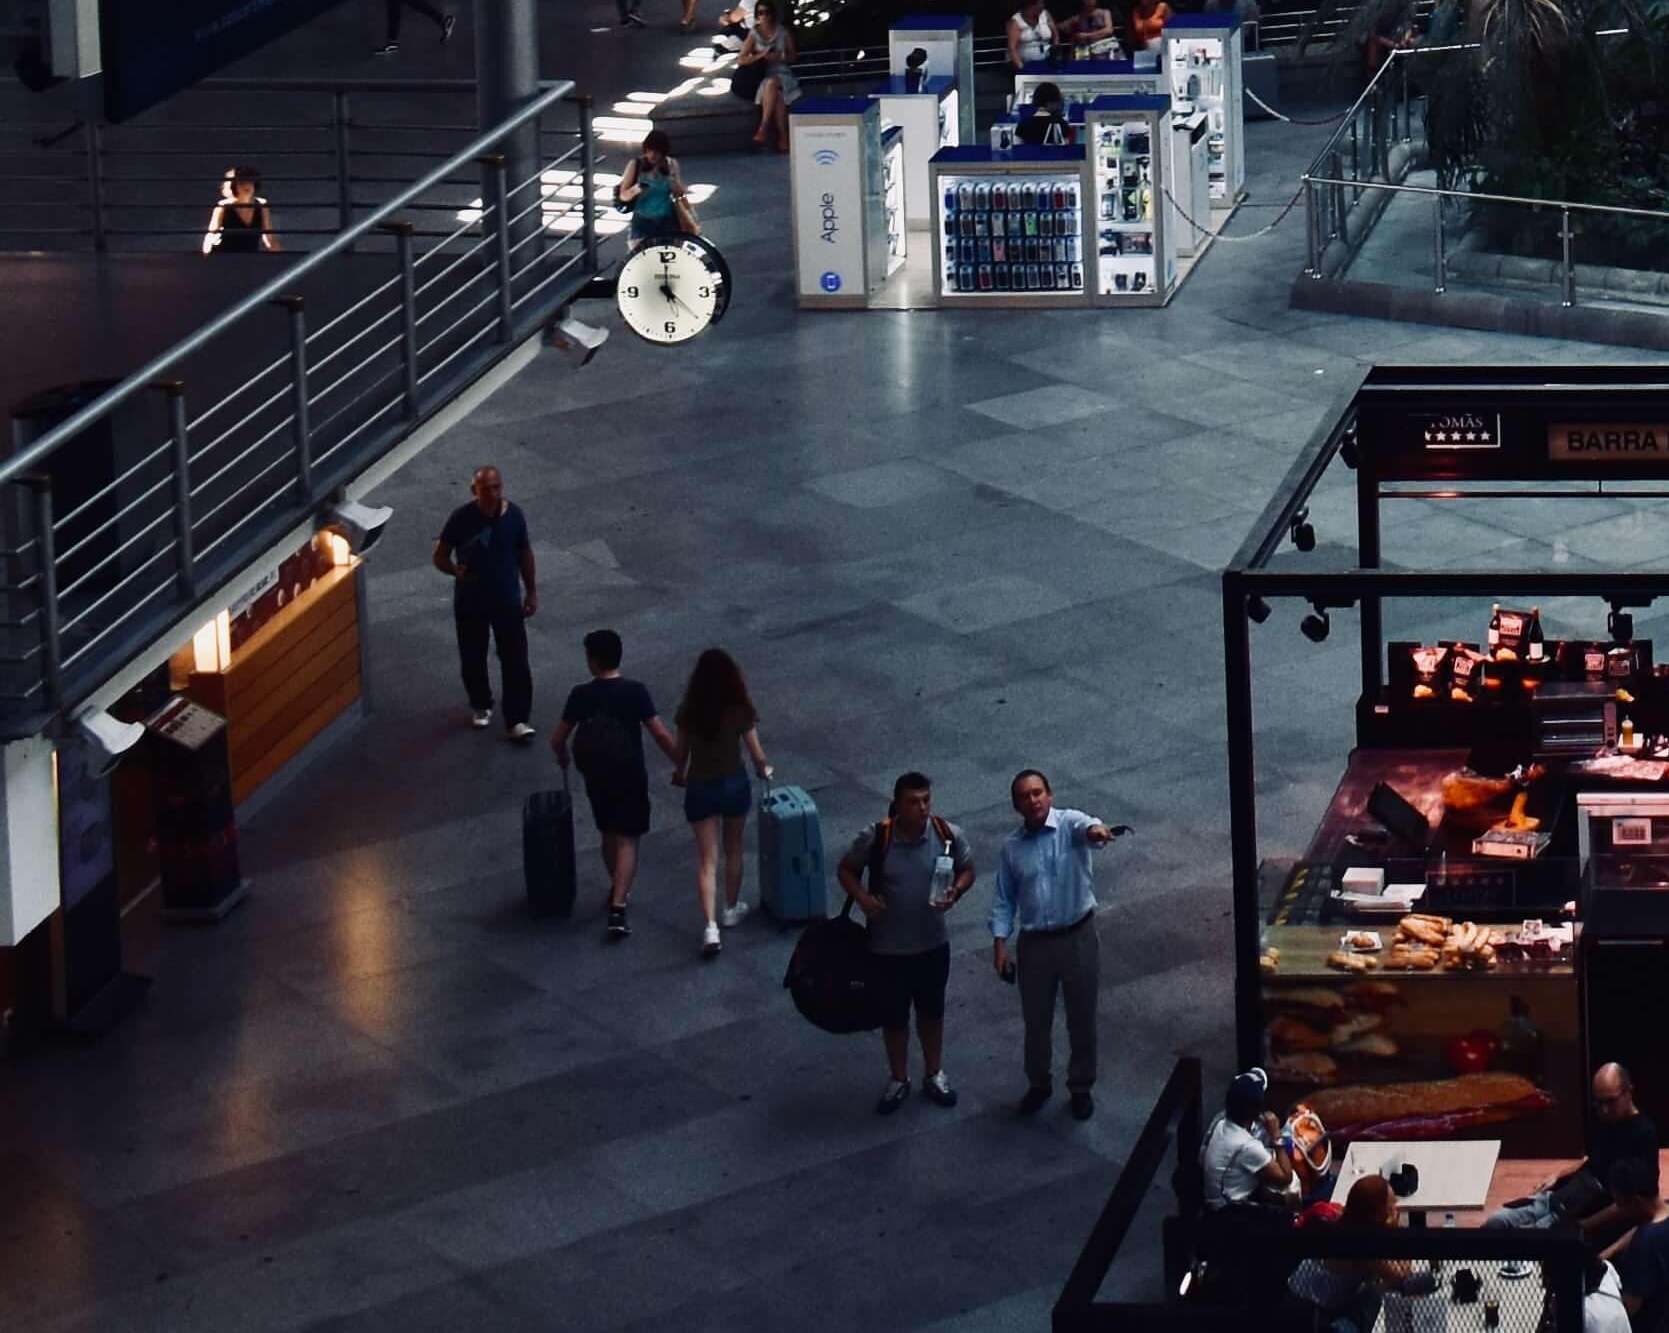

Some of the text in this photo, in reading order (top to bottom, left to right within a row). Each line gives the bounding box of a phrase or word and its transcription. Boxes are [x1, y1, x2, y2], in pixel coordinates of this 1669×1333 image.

[820, 192, 840, 244] Apple
[657, 251, 677, 264] 12
[627, 286, 639, 299] 9
[698, 285, 710, 299] 3
[664, 321, 676, 334] 6
[1568, 431, 1658, 452] BARRA
